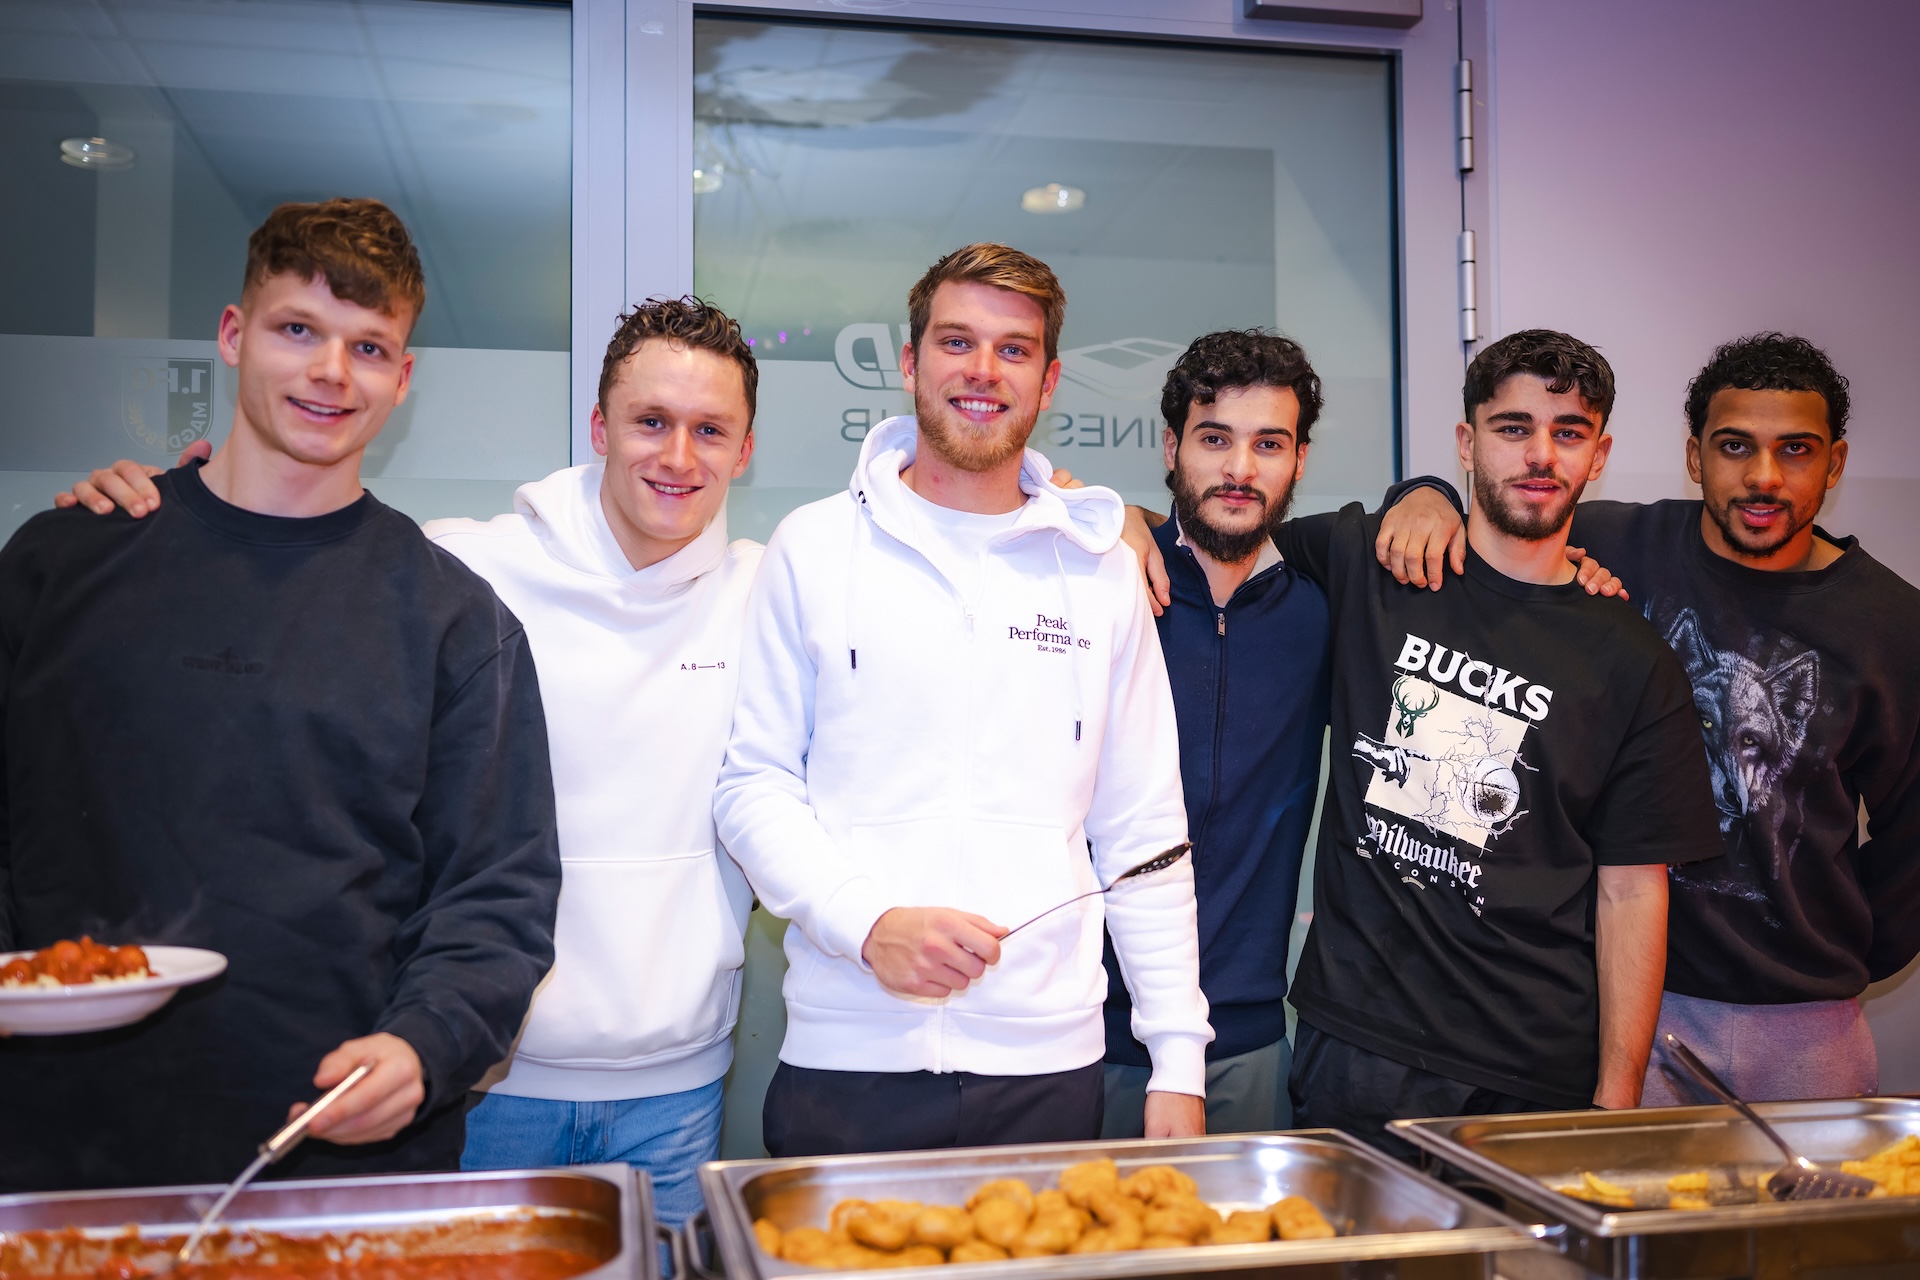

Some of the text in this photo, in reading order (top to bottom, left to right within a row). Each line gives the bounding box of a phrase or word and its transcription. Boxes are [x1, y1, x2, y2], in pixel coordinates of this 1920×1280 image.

[1008, 626, 1091, 649] Performace
[1036, 613, 1068, 630] Peak
[1394, 633, 1553, 721] BUCKS
[1357, 836, 1485, 905] WICONSIN
[1365, 812, 1483, 889] Milwaukee
